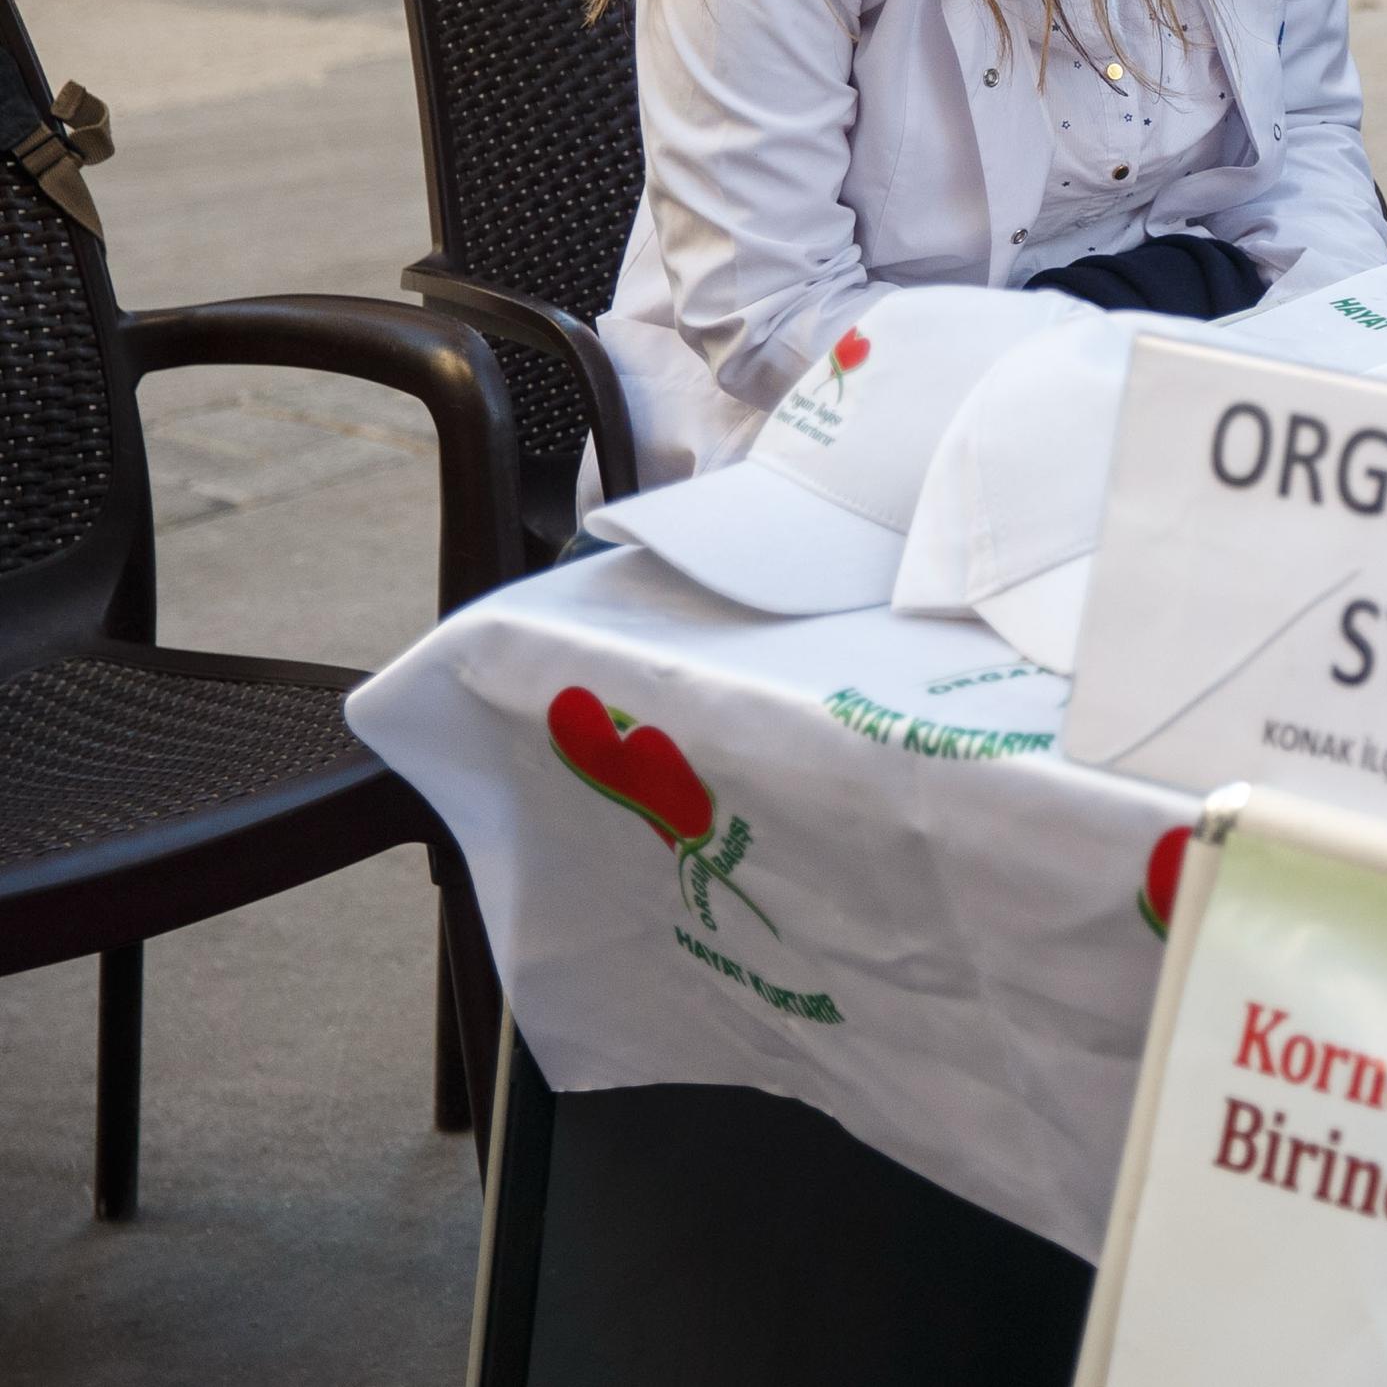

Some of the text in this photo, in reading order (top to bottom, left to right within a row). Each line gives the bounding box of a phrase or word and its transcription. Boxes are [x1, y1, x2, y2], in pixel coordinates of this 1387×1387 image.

[823, 687, 1056, 759] HAYAT KURTARIR
[1261, 719, 1356, 766] KONAK
[691, 815, 754, 931] ORGAN BAĞIŞI
[674, 925, 845, 1025] HAYAT KURTARIR
